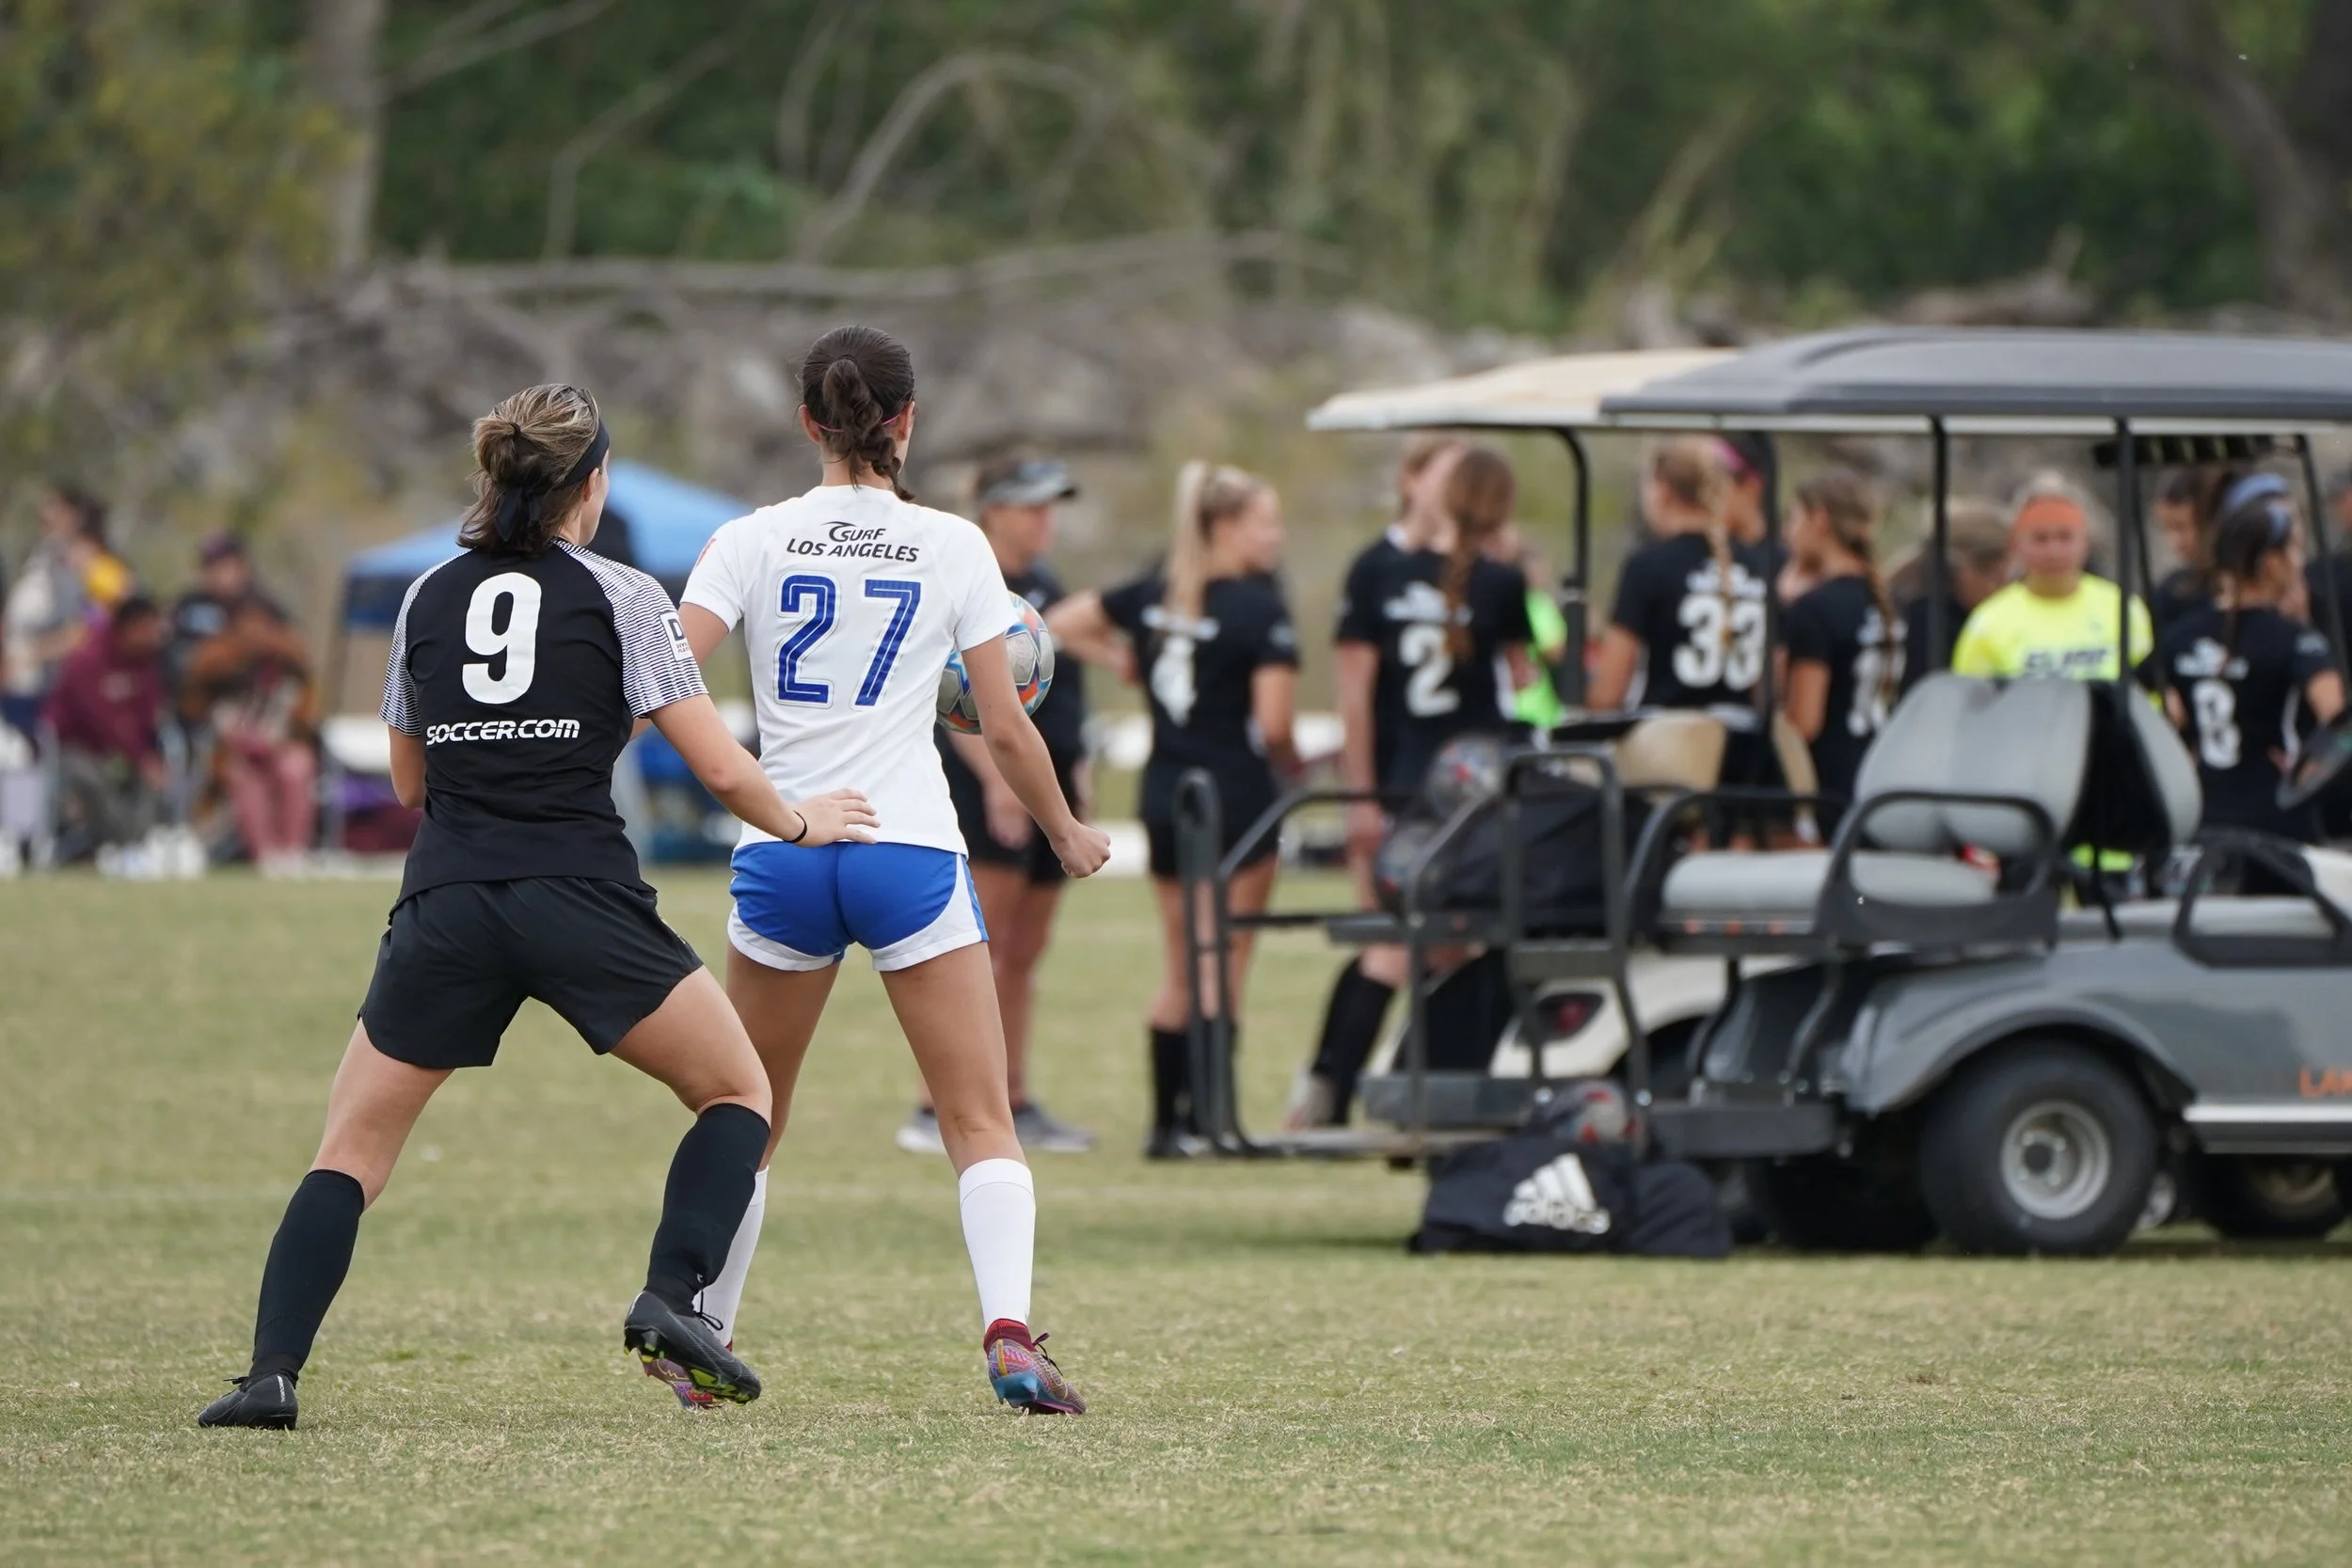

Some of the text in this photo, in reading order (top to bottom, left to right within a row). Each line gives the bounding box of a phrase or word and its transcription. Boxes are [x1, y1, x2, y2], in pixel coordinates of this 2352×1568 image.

[787, 538, 920, 562] LOS ANGELES
[462, 572, 542, 705] 9
[776, 573, 923, 707] 27
[1398, 624, 1461, 718] 2
[1672, 593, 1768, 690] 33
[426, 719, 580, 745] SOCCER.COM
